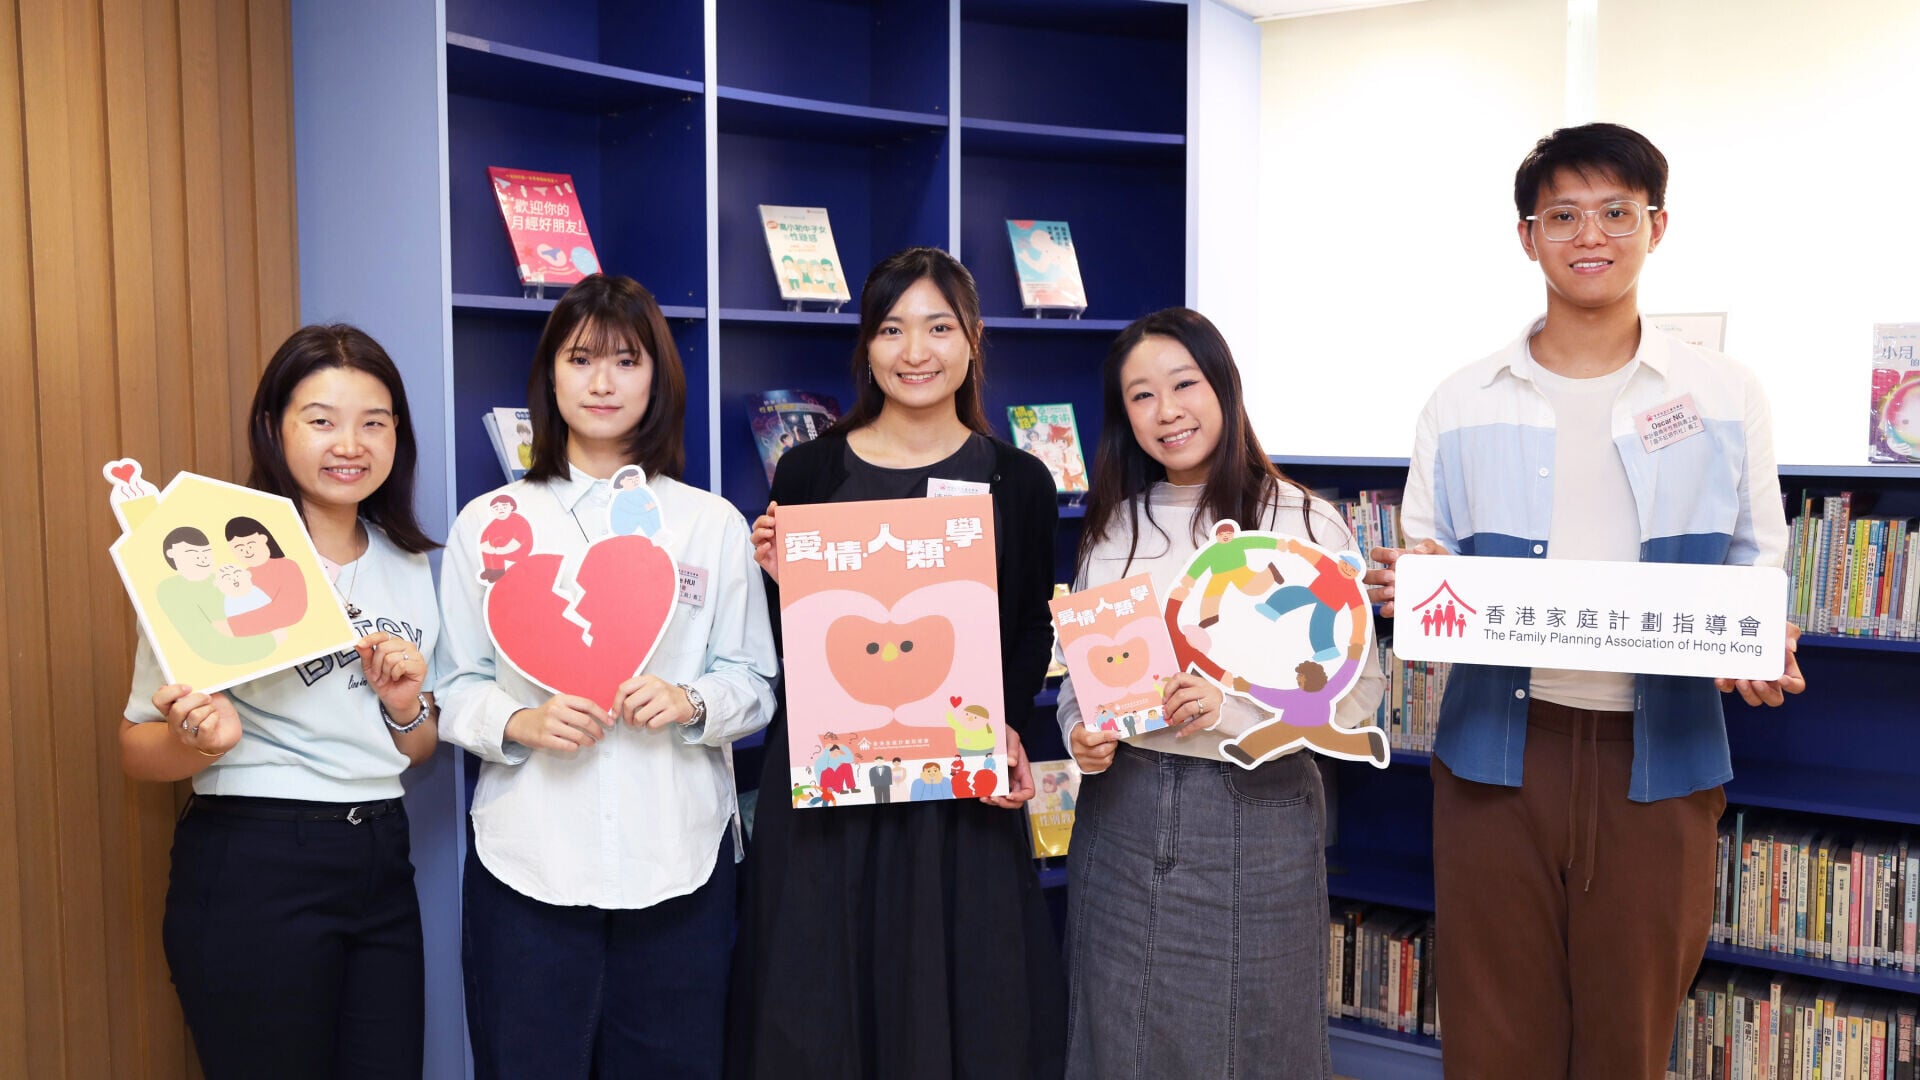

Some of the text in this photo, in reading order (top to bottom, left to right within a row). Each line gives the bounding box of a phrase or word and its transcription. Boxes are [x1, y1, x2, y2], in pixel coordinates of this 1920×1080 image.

[514, 200, 569, 217] 歡迎你的
[1651, 412, 1685, 430] Oscar NG
[1485, 605, 1761, 638] 香港家庭計劃指導會
[1484, 628, 1763, 657] The Family Planning Association of Hong Kong
